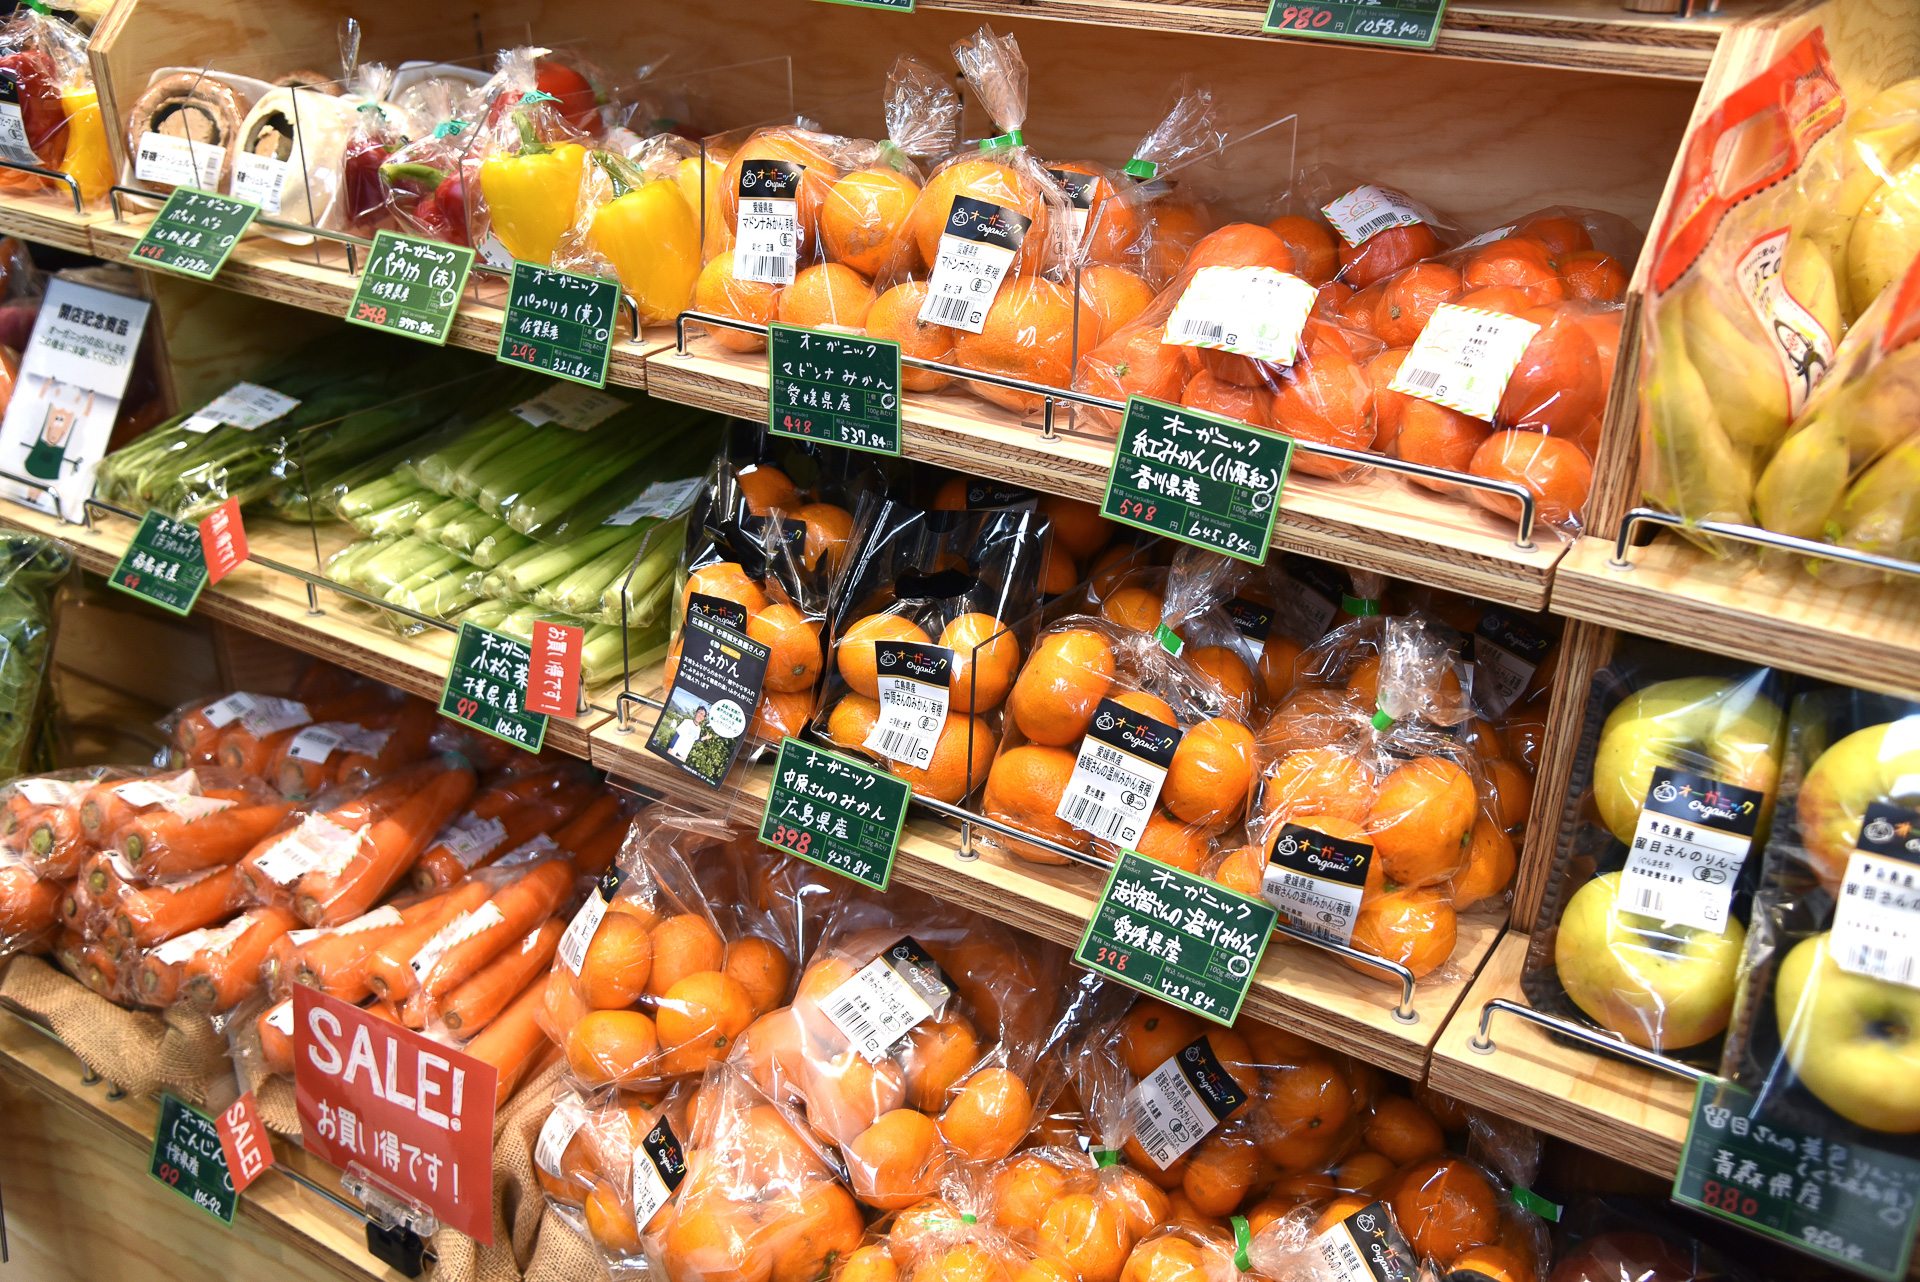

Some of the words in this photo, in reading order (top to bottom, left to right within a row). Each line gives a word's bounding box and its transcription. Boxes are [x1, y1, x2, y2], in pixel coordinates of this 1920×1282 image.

[1279, 7, 1332, 30] 980
[1335, 22, 1344, 30] 円
[1355, 18, 1418, 37] 1058.40
[1416, 30, 1426, 39] 円
[757, 168, 797, 181] オーガニック
[765, 180, 786, 192] Organic
[969, 210, 1023, 234] オーガニック
[977, 223, 1008, 238] Organic
[393, 241, 455, 264] オーガニック
[533, 270, 599, 296] オーガニック
[356, 303, 387, 325] 348
[520, 317, 559, 340] 佐賀県産
[510, 344, 537, 362] 298
[542, 358, 548, 366] 円
[800, 333, 876, 358] オーガニック
[787, 383, 851, 411] 愛媛県産
[1132, 411, 1150, 420] Product
[1163, 415, 1260, 456] オーガニック
[1131, 464, 1202, 506] 香川県産
[1119, 499, 1157, 522] 598
[1169, 521, 1179, 530] 円
[1248, 544, 1257, 554] 円
[703, 604, 744, 624] オーガニック
[481, 633, 532, 662] オーガニッ
[897, 650, 947, 670] オーガニック
[470, 650, 529, 690] 小松菜
[703, 648, 740, 678] みかん
[907, 661, 936, 674] Organic
[457, 697, 478, 720] 99
[463, 676, 518, 713] 千葉県産
[1115, 717, 1174, 750] オーガニック
[1122, 731, 1159, 752] Organic
[785, 751, 799, 760] Product
[806, 751, 876, 790] オーガニック
[783, 768, 886, 821] 中原さんのみかん
[1678, 784, 1755, 815] オーガニック
[779, 796, 849, 840] 広島県産
[1688, 799, 1738, 820] Organic
[772, 825, 812, 854] 398
[812, 848, 820, 857] 円
[1651, 821, 1695, 842] 青森県産
[827, 849, 872, 879] 429.84
[873, 873, 880, 882] 円
[1299, 839, 1365, 867] オーガニック
[1307, 854, 1350, 871] Organic
[1634, 836, 1743, 872] 留目さんのりんご
[1122, 864, 1141, 875] Product
[1284, 874, 1315, 891] 愛媛県産
[1150, 868, 1252, 920] オーガニック
[1112, 915, 1183, 964] 愛媛県産
[909, 954, 949, 996] オーガニック
[1096, 947, 1129, 971] 398
[1143, 974, 1153, 983] 円
[909, 968, 934, 994] Organic
[1186, 975, 1206, 988] included
[1161, 977, 1216, 1011] 429.84
[1219, 1006, 1229, 1016] 円
[308, 1006, 465, 1132] SALE!
[1198, 1056, 1236, 1104] オーガニック
[1196, 1071, 1220, 1102] Organic
[172, 1119, 227, 1167] にんじん
[226, 1101, 263, 1180] SALE!
[317, 1099, 459, 1204] お買い得です!
[659, 1134, 685, 1174] オーガニック
[160, 1163, 180, 1187] 99
[658, 1148, 674, 1174] Organic
[1713, 1149, 1823, 1211] 青森県産
[1703, 1180, 1758, 1216] 880
[1371, 1243, 1394, 1280] Organic
